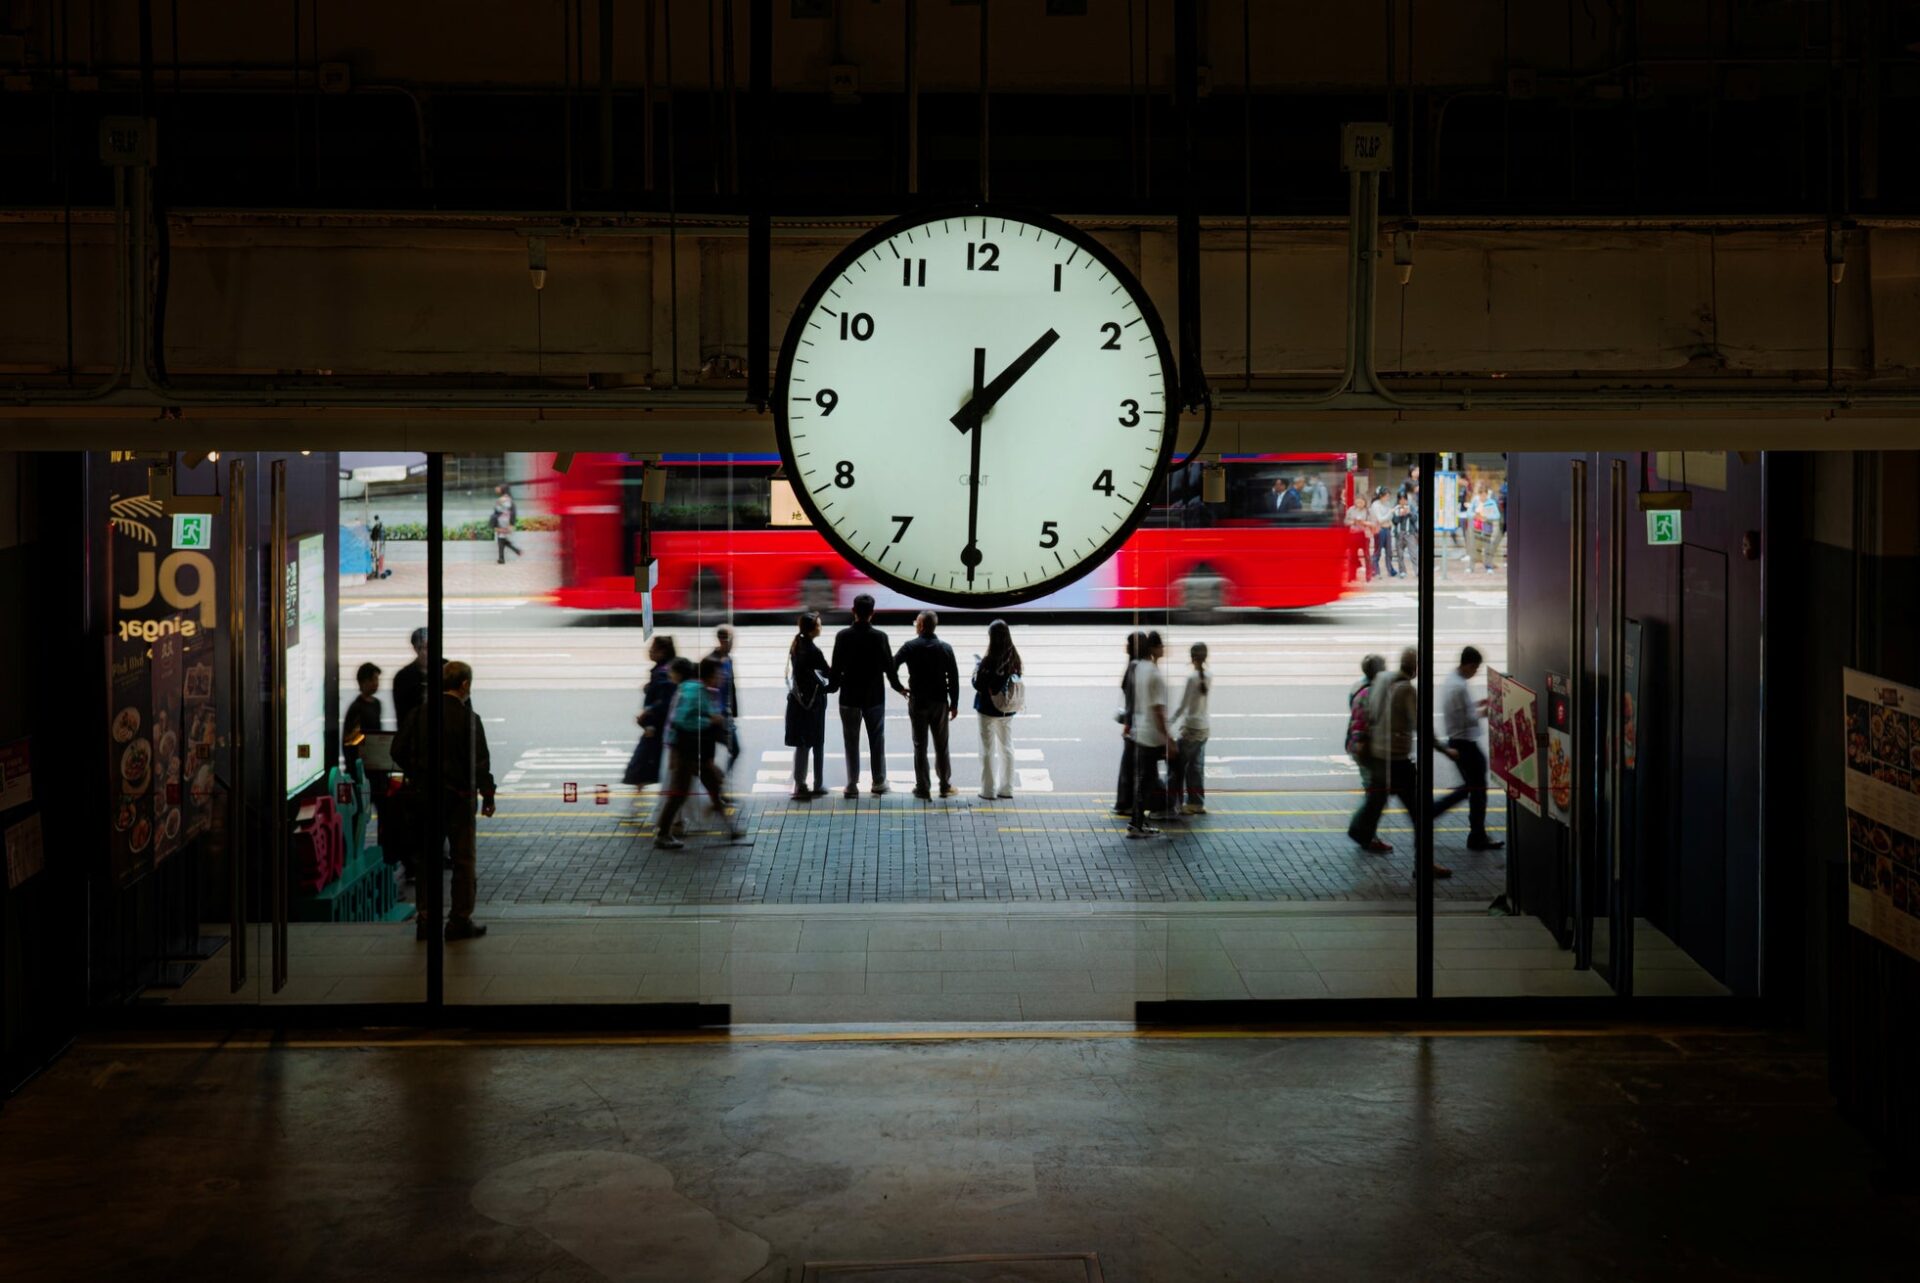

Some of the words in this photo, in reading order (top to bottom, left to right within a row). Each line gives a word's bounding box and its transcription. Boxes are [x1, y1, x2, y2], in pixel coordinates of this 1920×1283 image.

[967, 243, 999, 271] 12
[903, 258, 926, 287] 11
[1054, 264, 1062, 292] 1
[840, 312, 874, 341] 10
[1101, 322, 1121, 350] 2
[816, 389, 838, 416] 9
[1119, 399, 1140, 427] 3
[834, 461, 854, 489] 8
[959, 473, 991, 487] GNT
[1093, 470, 1115, 496] 4
[892, 516, 914, 543] 7
[1039, 521, 1059, 548] 5
